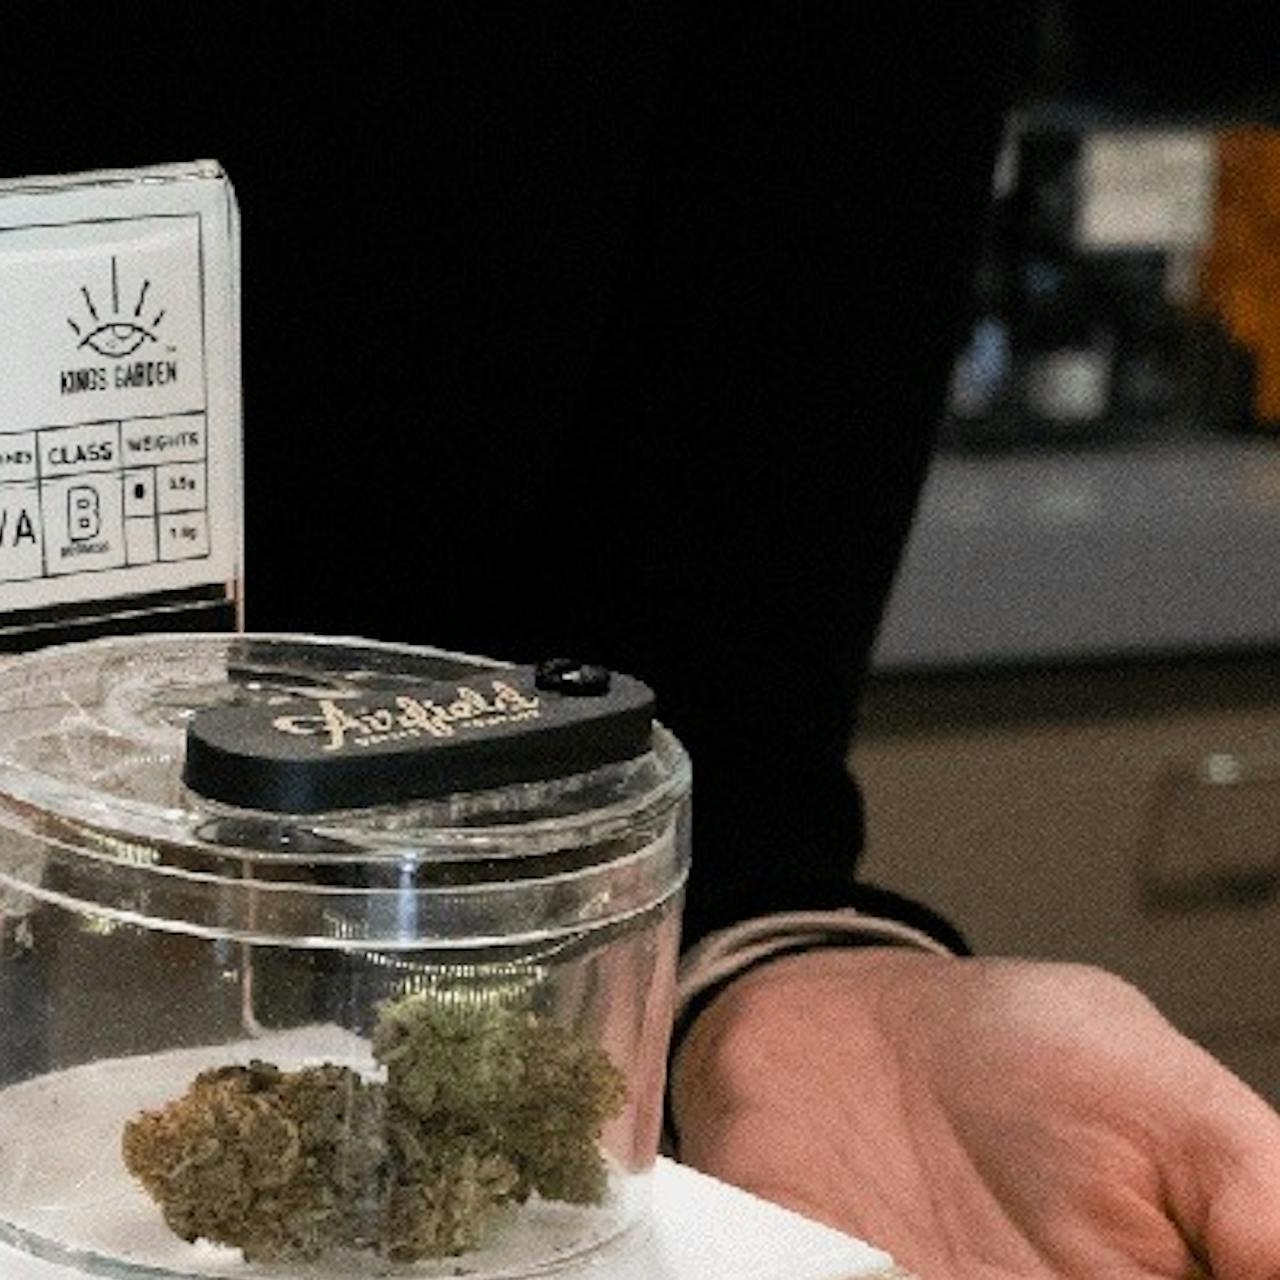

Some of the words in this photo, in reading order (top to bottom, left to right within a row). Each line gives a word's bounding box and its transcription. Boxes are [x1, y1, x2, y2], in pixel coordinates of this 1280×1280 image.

[60, 367, 108, 395] KINGS
[115, 361, 177, 389] GARDEN
[47, 441, 114, 466] CLASS
[126, 431, 200, 453] WEIGHTS
